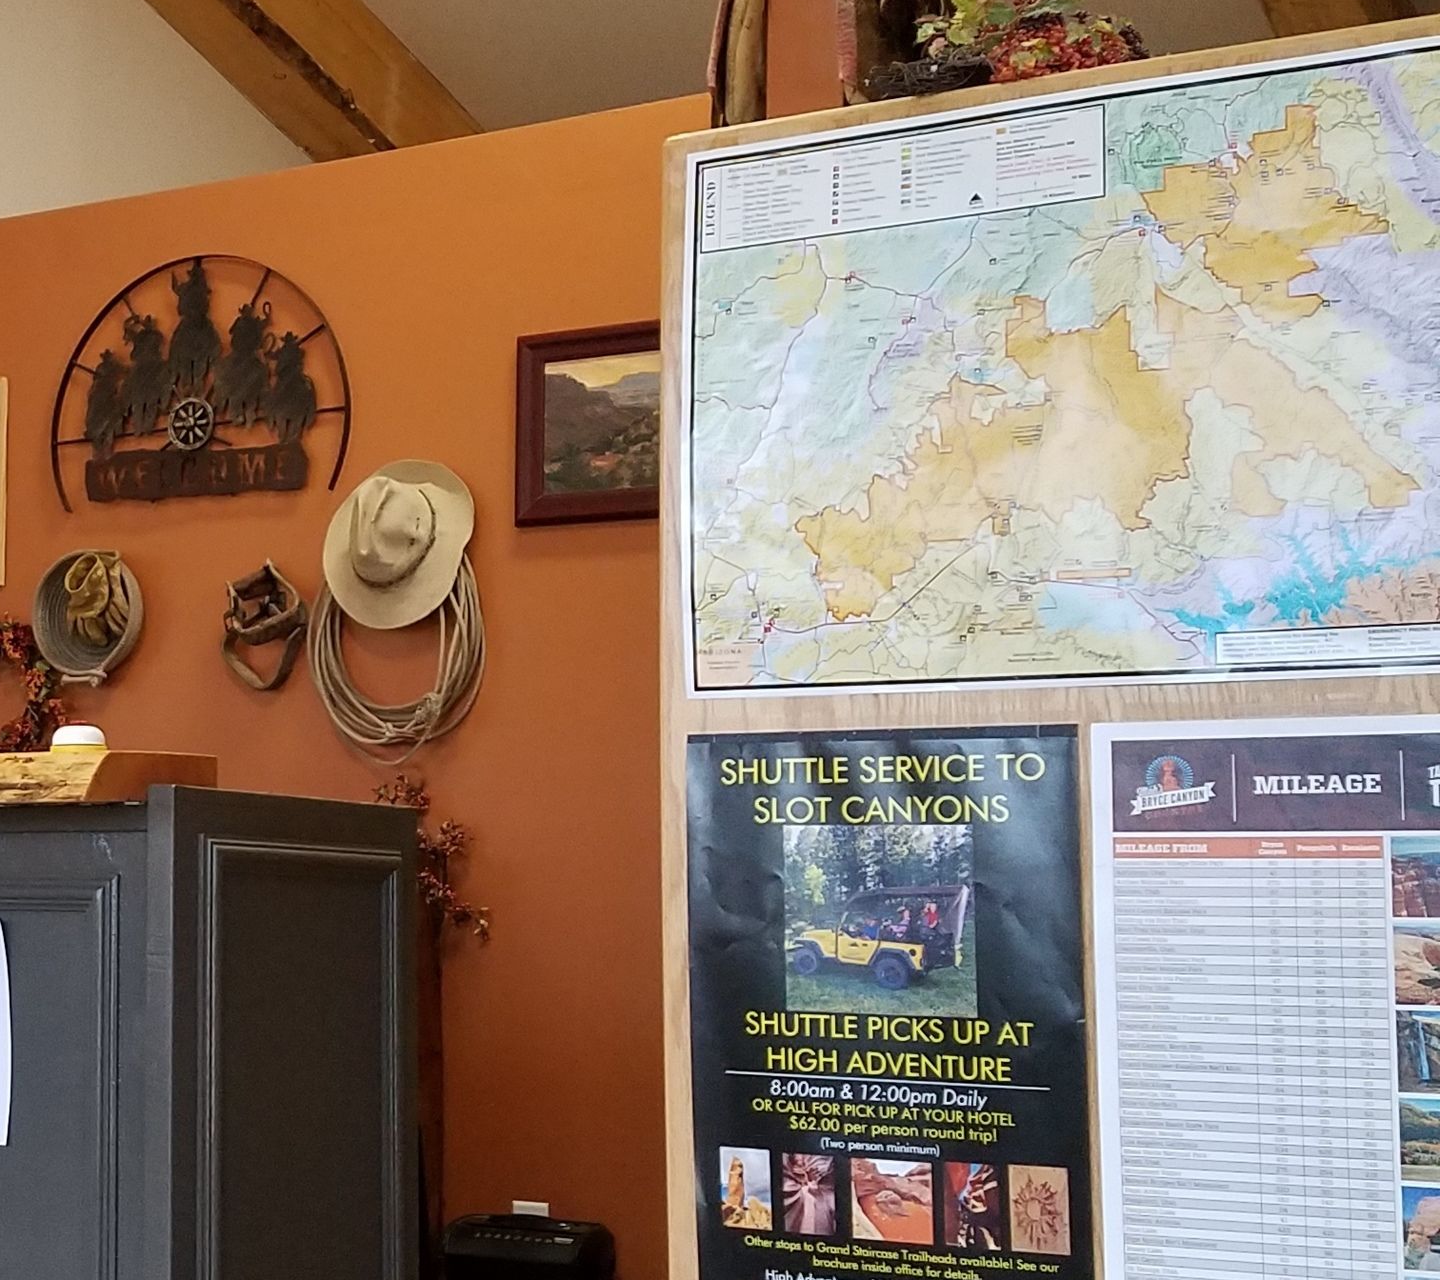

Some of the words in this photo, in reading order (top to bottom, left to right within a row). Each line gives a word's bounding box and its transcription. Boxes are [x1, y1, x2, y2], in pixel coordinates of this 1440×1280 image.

[720, 757, 850, 786] SHUTTLE
[859, 754, 985, 784] SERVICE
[995, 752, 1046, 781] TO
[1252, 773, 1382, 795] MILEAGE
[753, 796, 833, 824] SLOT
[841, 794, 1010, 824] CANYONS
[1142, 794, 1168, 808] BRYCE
[1170, 789, 1206, 804] CANYON
[745, 1010, 858, 1039] SHUTTLE
[867, 1016, 945, 1043] PICKS
[952, 1019, 990, 1045] UP
[996, 1021, 1034, 1047] AT
[767, 1046, 838, 1073] HIGH
[846, 1050, 1012, 1082] ADVENTURE
[770, 1079, 835, 1099] 8:00am
[840, 1083, 854, 1100] &
[860, 1083, 937, 1107] 12:00pm
[943, 1087, 988, 1111] Daily
[752, 1098, 773, 1112] OR
[775, 1099, 809, 1114] CALL
[812, 1102, 841, 1116] FOR
[844, 1103, 876, 1119] PICK
[879, 1105, 898, 1119] UP
[901, 1107, 920, 1121] AT
[922, 1108, 965, 1124] YOUR
[967, 1111, 1016, 1127] HOTEL
[789, 1115, 840, 1132] $62.00
[843, 1121, 868, 1136] per
[871, 1124, 919, 1138] person
[923, 1126, 965, 1140] round
[968, 1127, 998, 1145] trip!
[820, 1136, 846, 1150] (Two
[848, 1141, 884, 1153] person
[886, 1141, 940, 1158] minimum)
[744, 1234, 773, 1248] Other
[775, 1239, 802, 1253] stops
[803, 1242, 814, 1252] to
[816, 1241, 850, 1255] Grand
[852, 1245, 899, 1260] Staircase
[901, 1249, 957, 1265] Trailheads
[1016, 1258, 1037, 1272] See
[1039, 1263, 1060, 1274] our
[812, 1255, 859, 1270] brochure
[861, 1260, 892, 1274] inside
[895, 1263, 924, 1277] office
[925, 1265, 941, 1279] for
